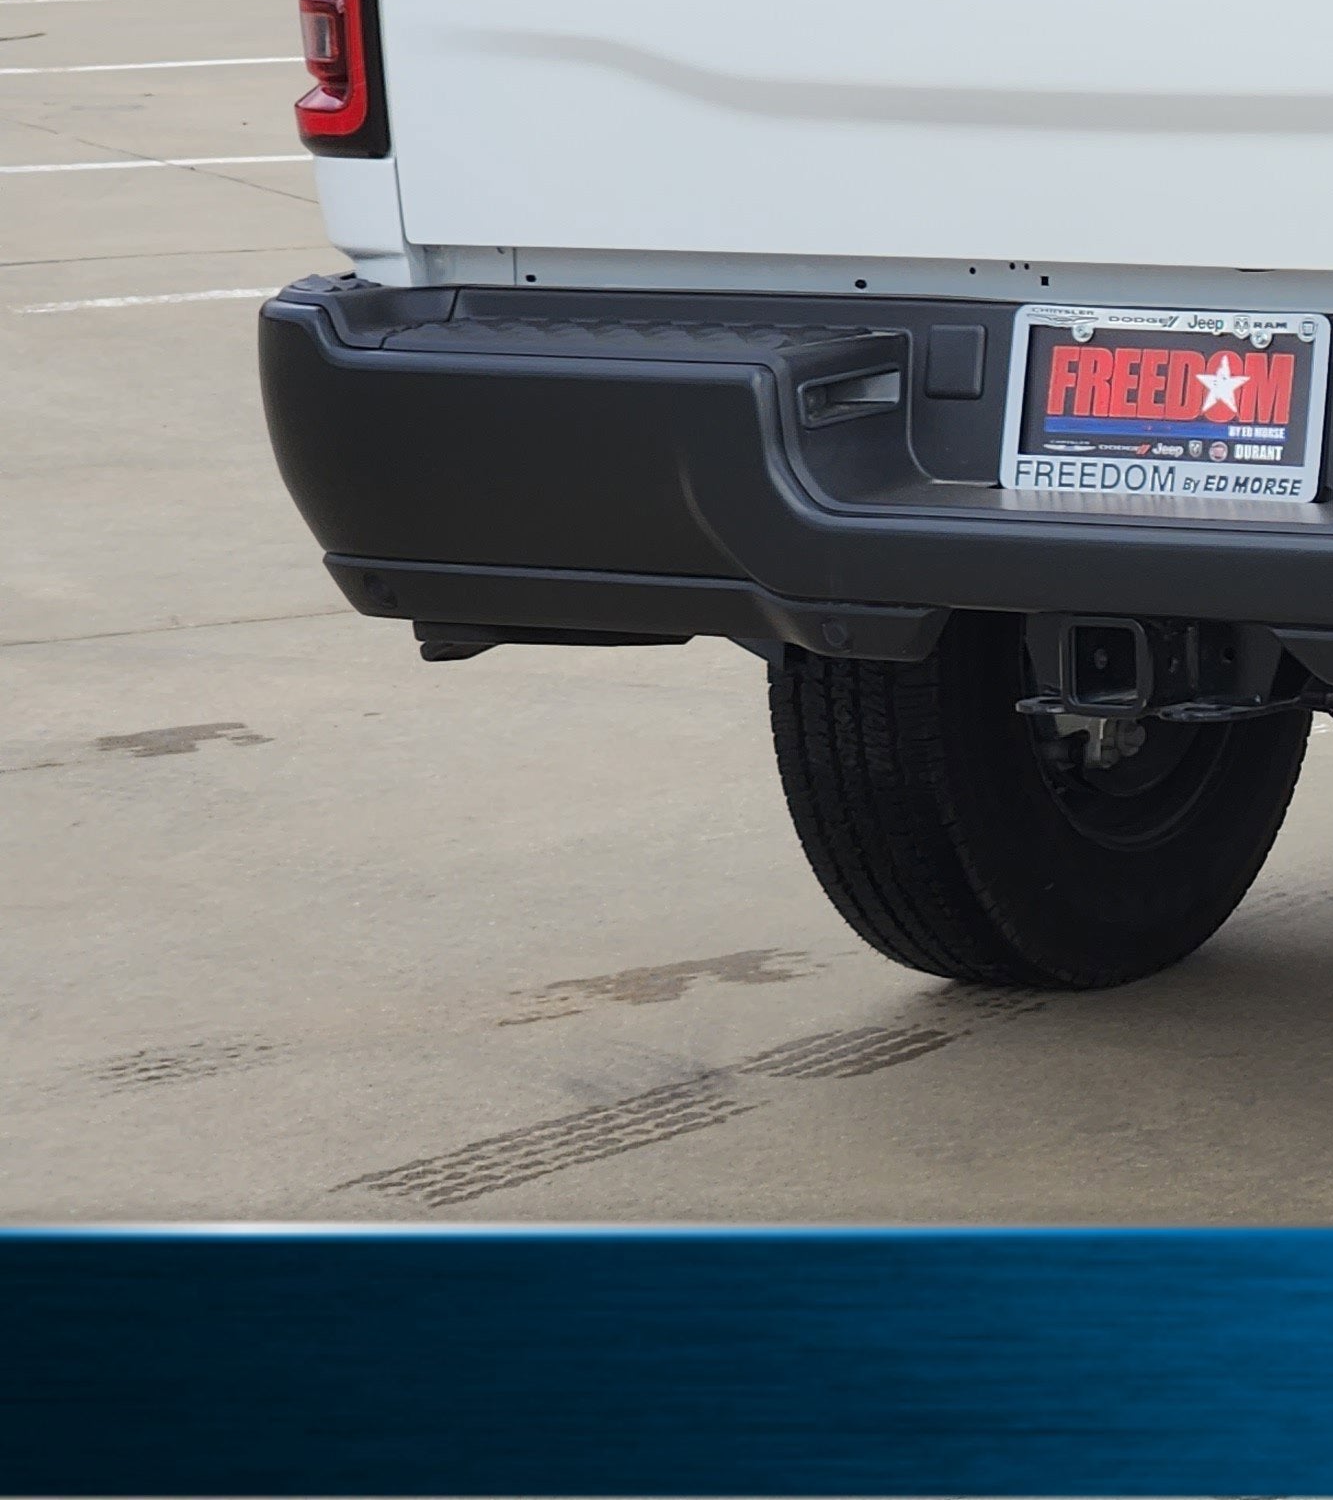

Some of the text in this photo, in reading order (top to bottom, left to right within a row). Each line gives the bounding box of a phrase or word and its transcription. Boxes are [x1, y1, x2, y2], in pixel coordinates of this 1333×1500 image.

[1108, 315, 1171, 326] DODGE
[1187, 314, 1225, 332] Jeep
[1253, 321, 1288, 330] RAM
[1046, 345, 1295, 425] FREEDOM
[1152, 442, 1184, 458] Jeep
[1234, 443, 1284, 461] DURANT
[1014, 459, 1177, 492] FREEDOM
[1203, 474, 1229, 492] ED
[1232, 476, 1303, 497] MORSE
